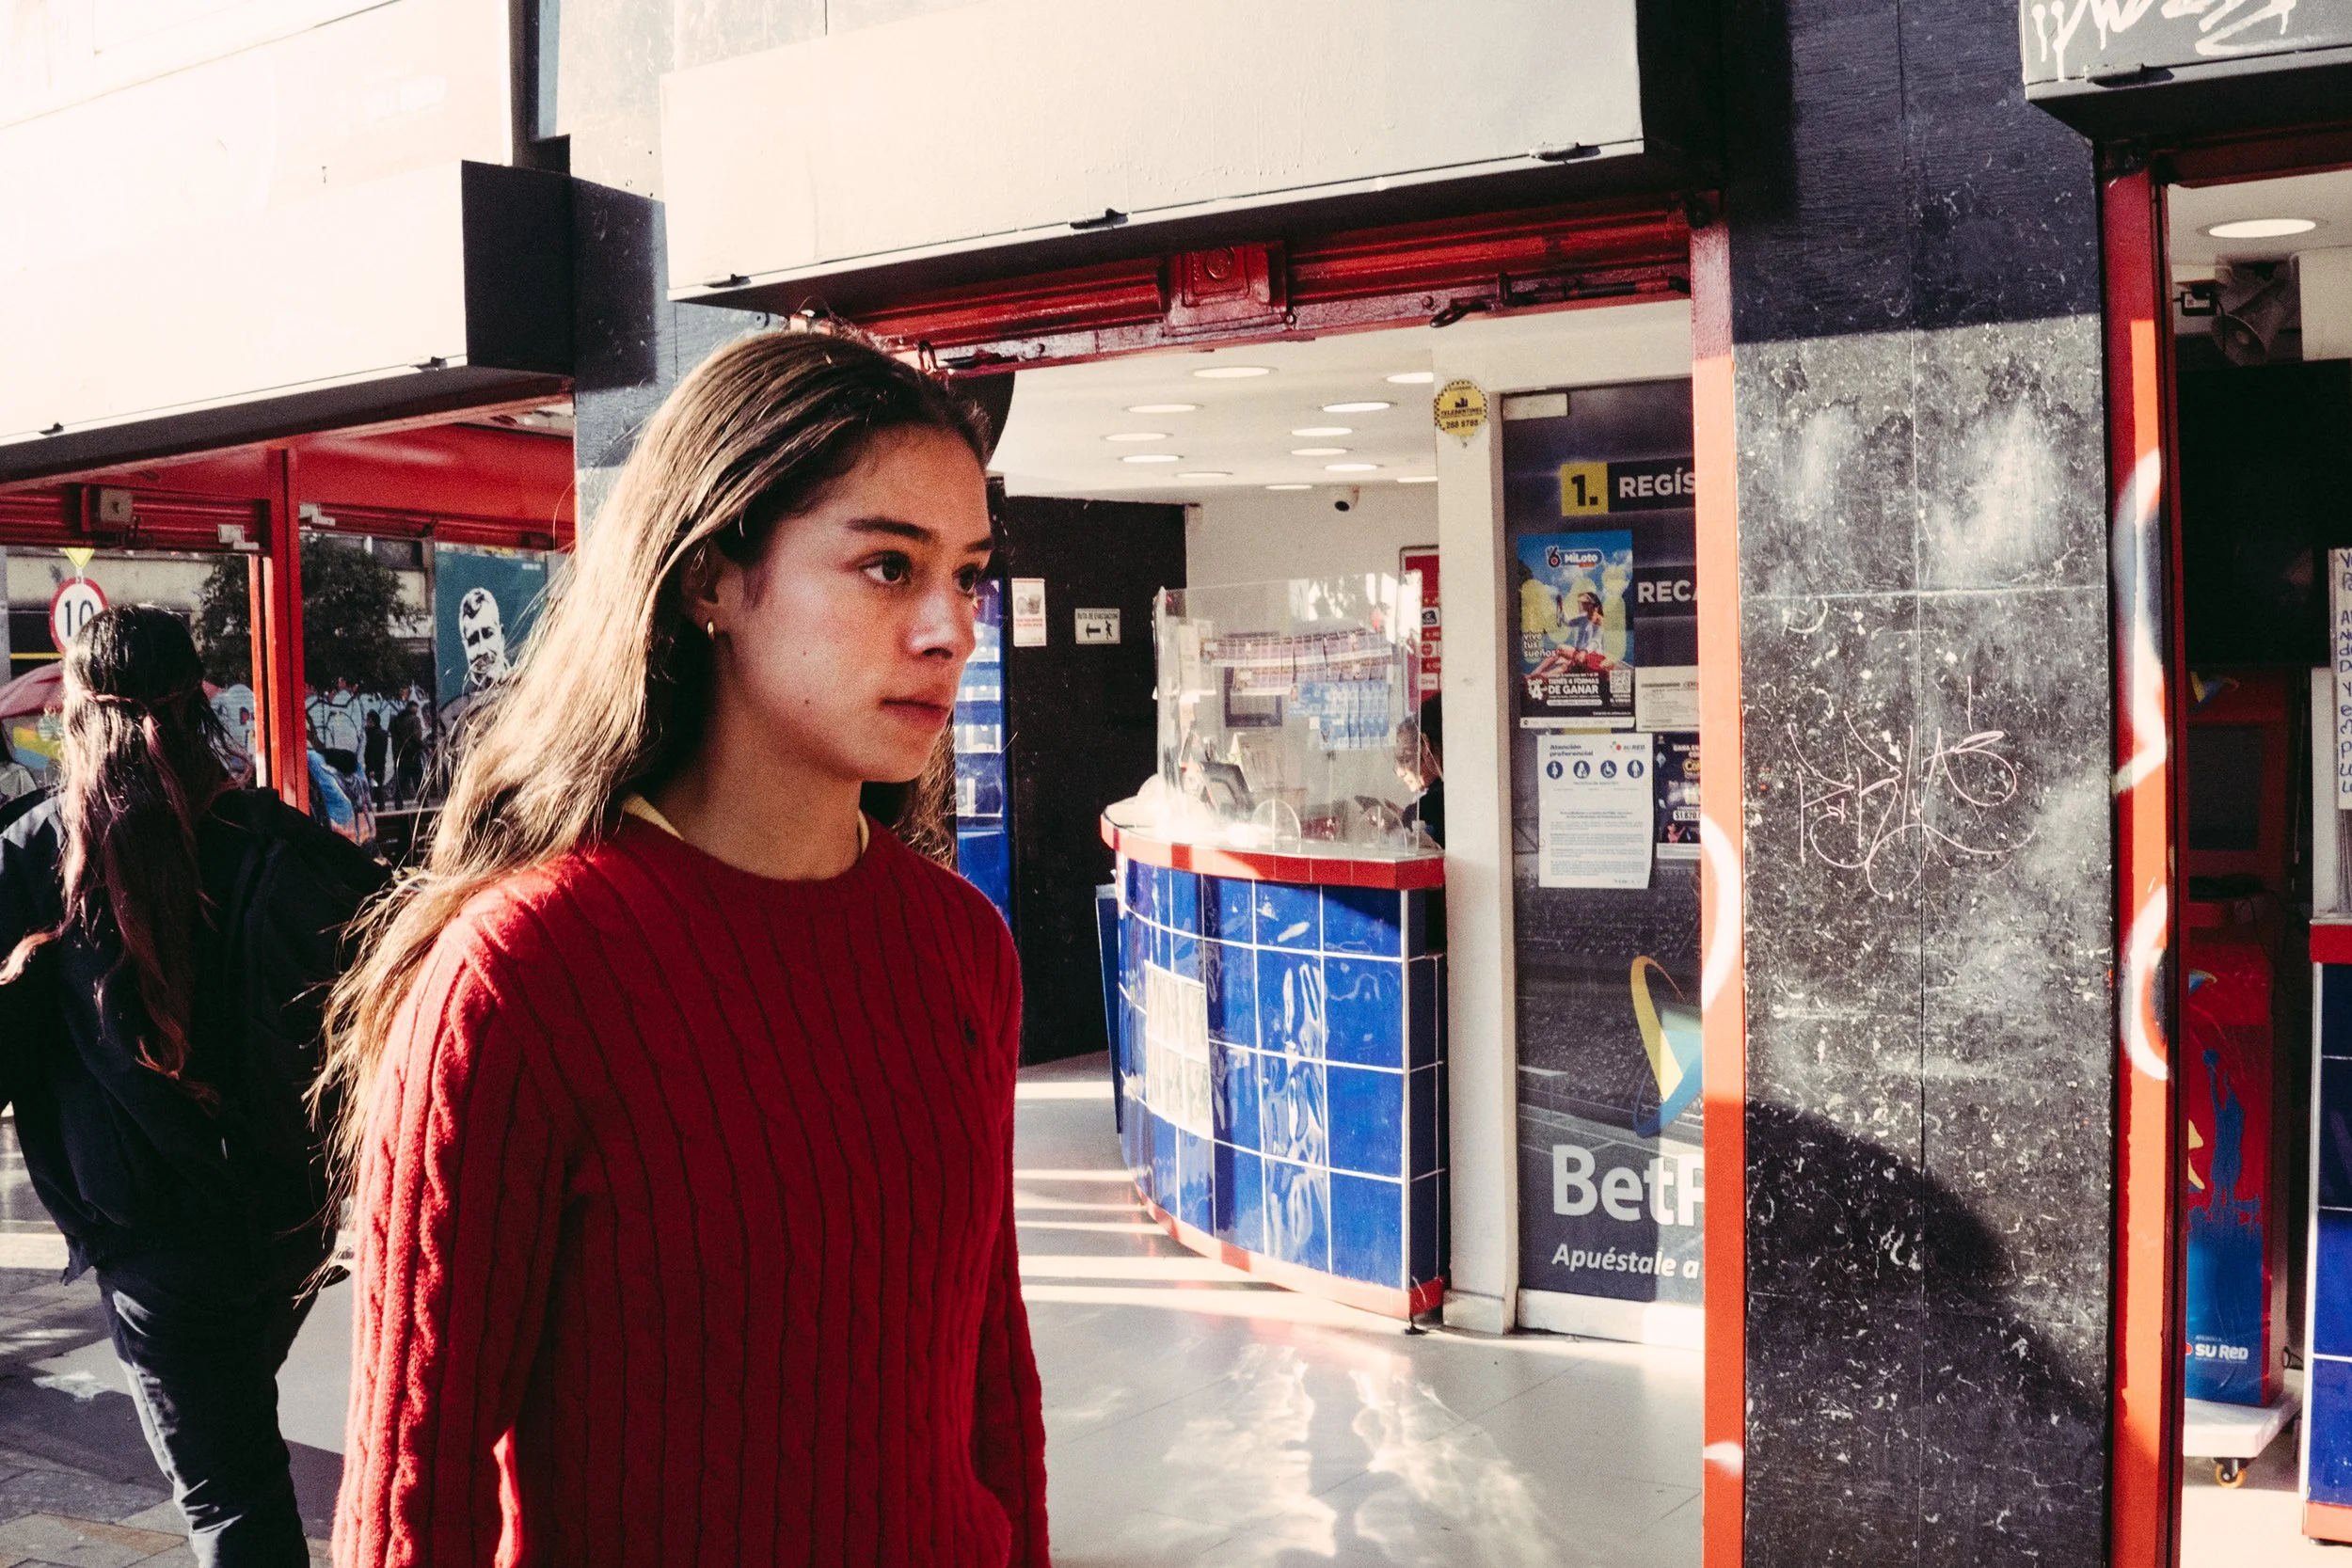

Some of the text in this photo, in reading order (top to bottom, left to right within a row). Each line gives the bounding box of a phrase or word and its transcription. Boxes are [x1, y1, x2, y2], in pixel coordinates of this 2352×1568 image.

[1570, 474, 1598, 506] 1.
[1637, 579, 1697, 604] REC
[1523, 631, 1543, 640] vive
[1523, 640, 1538, 648] tus
[1548, 684, 1599, 694] DE GANAR
[1551, 1243, 1700, 1279] Apuéstale a
[2194, 1343, 2217, 1357] SU
